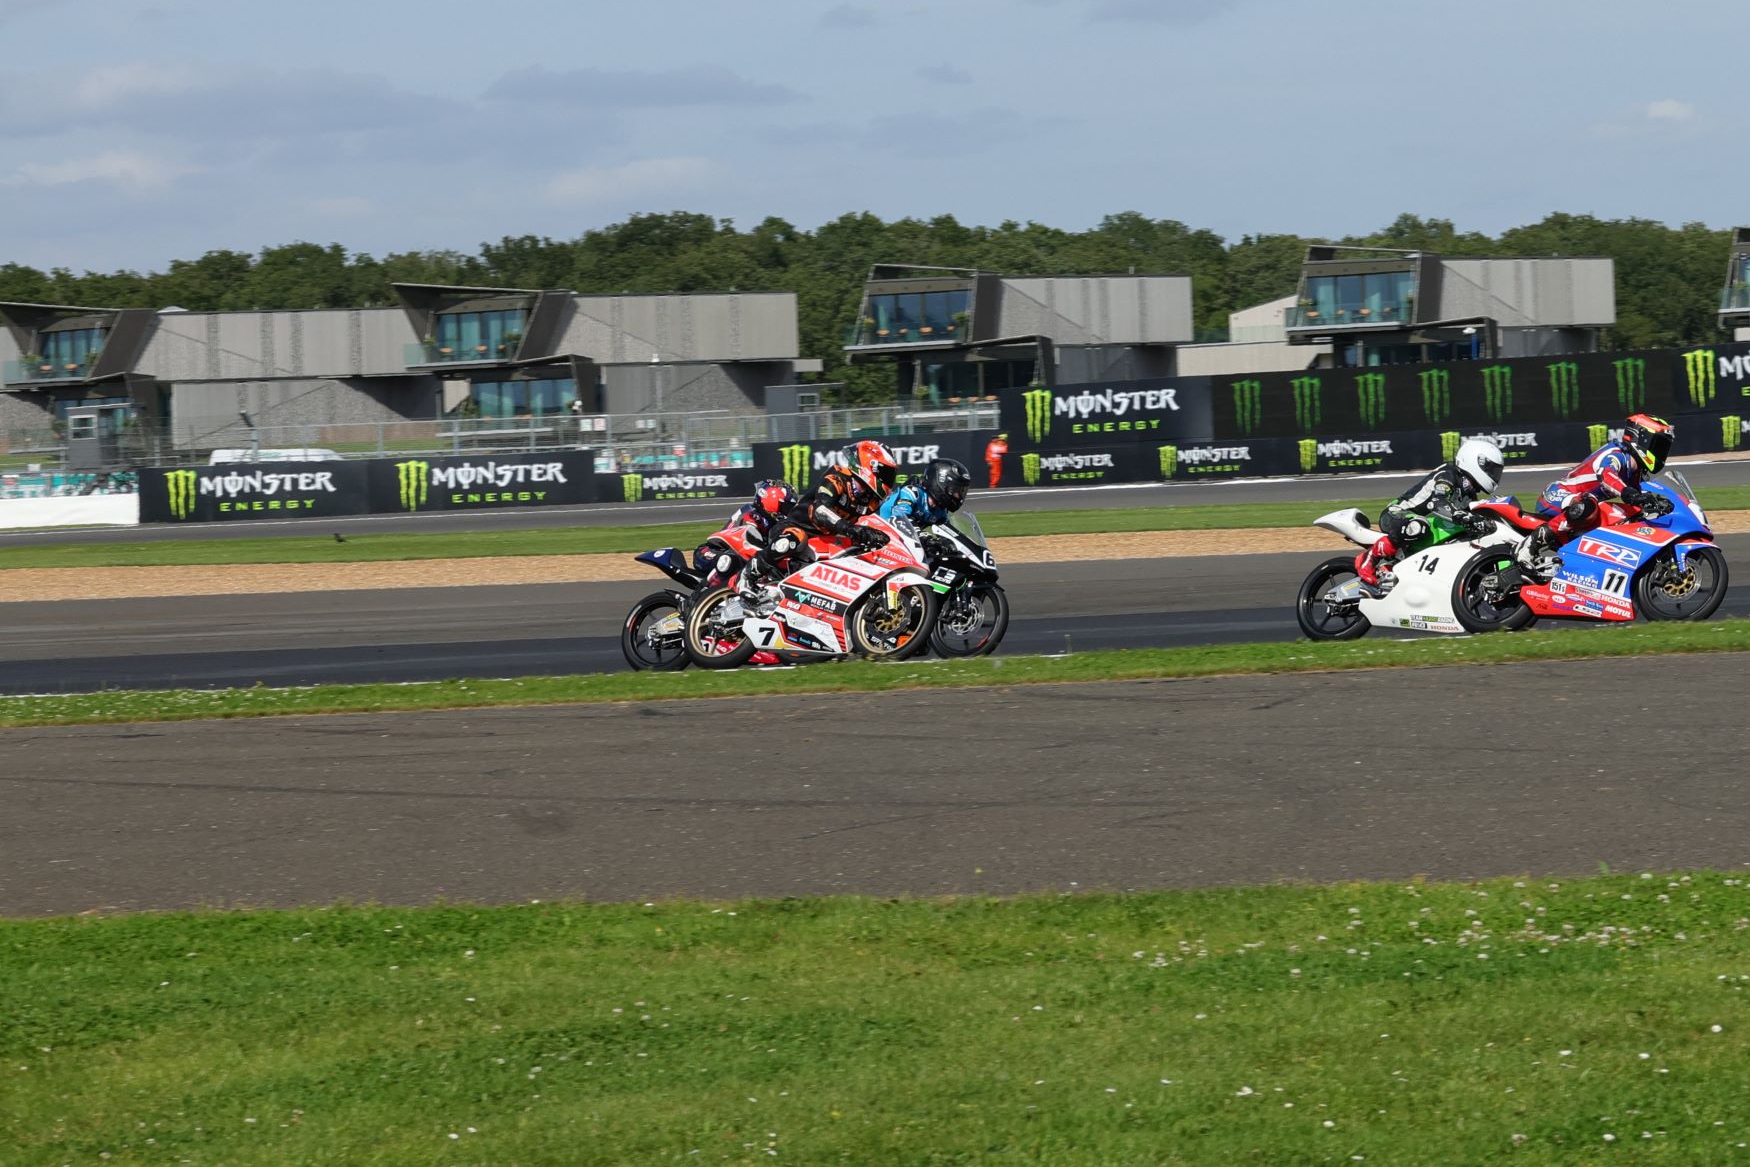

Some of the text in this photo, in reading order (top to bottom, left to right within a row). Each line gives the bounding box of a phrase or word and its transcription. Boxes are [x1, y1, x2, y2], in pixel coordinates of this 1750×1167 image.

[1054, 388, 1180, 418] MONSTER
[1072, 420, 1160, 434] ENERGY
[200, 470, 337, 497] MONSTER
[431, 461, 567, 489] MONSTER
[220, 499, 315, 511] ENERGY
[452, 491, 546, 503] ENERGY
[1418, 554, 1440, 575] 14
[810, 565, 861, 591] ATLAS
[1604, 572, 1625, 593] 11
[810, 596, 837, 611] MEFAB
[1601, 595, 1631, 608] HONDA
[1605, 605, 1631, 618] MOTUL
[759, 627, 775, 646] 7
